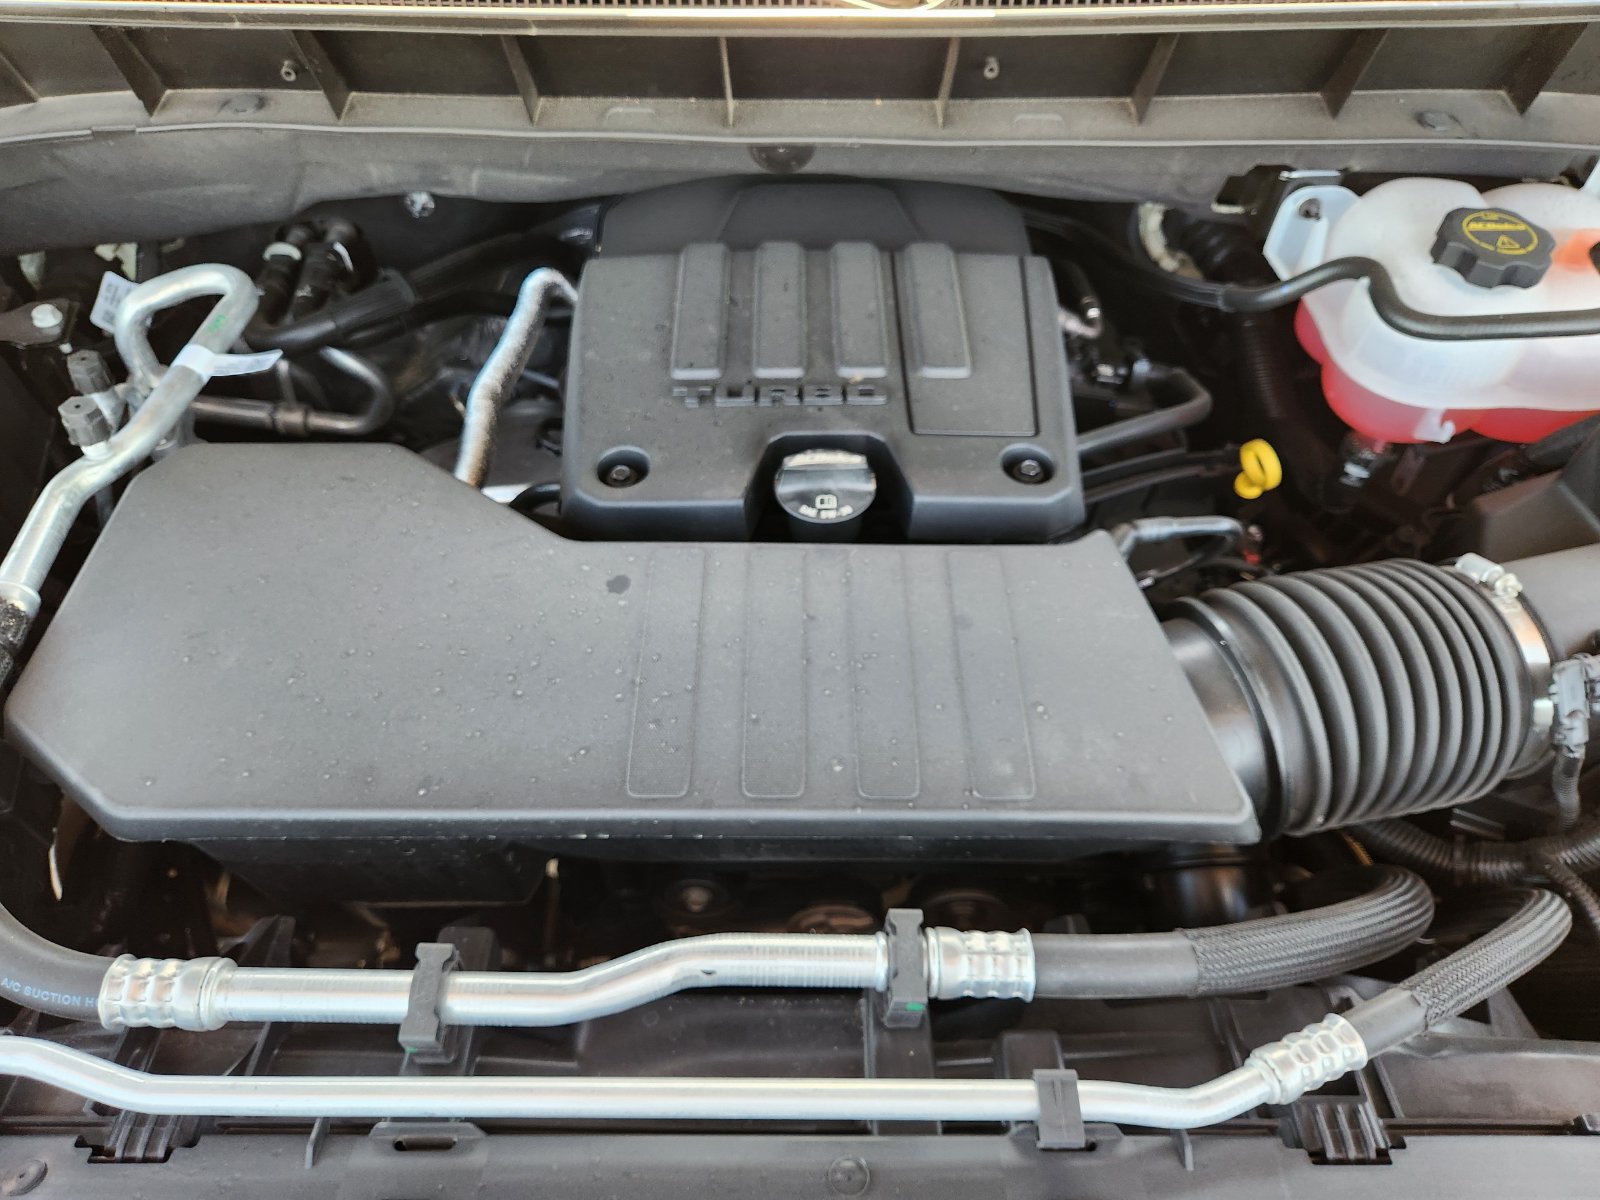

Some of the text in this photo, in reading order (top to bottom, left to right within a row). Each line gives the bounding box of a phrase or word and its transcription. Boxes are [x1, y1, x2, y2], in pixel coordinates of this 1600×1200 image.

[672, 385, 888, 408] TURBO
[0, 977, 21, 992] A/C
[23, 985, 81, 1006] SUCTION
